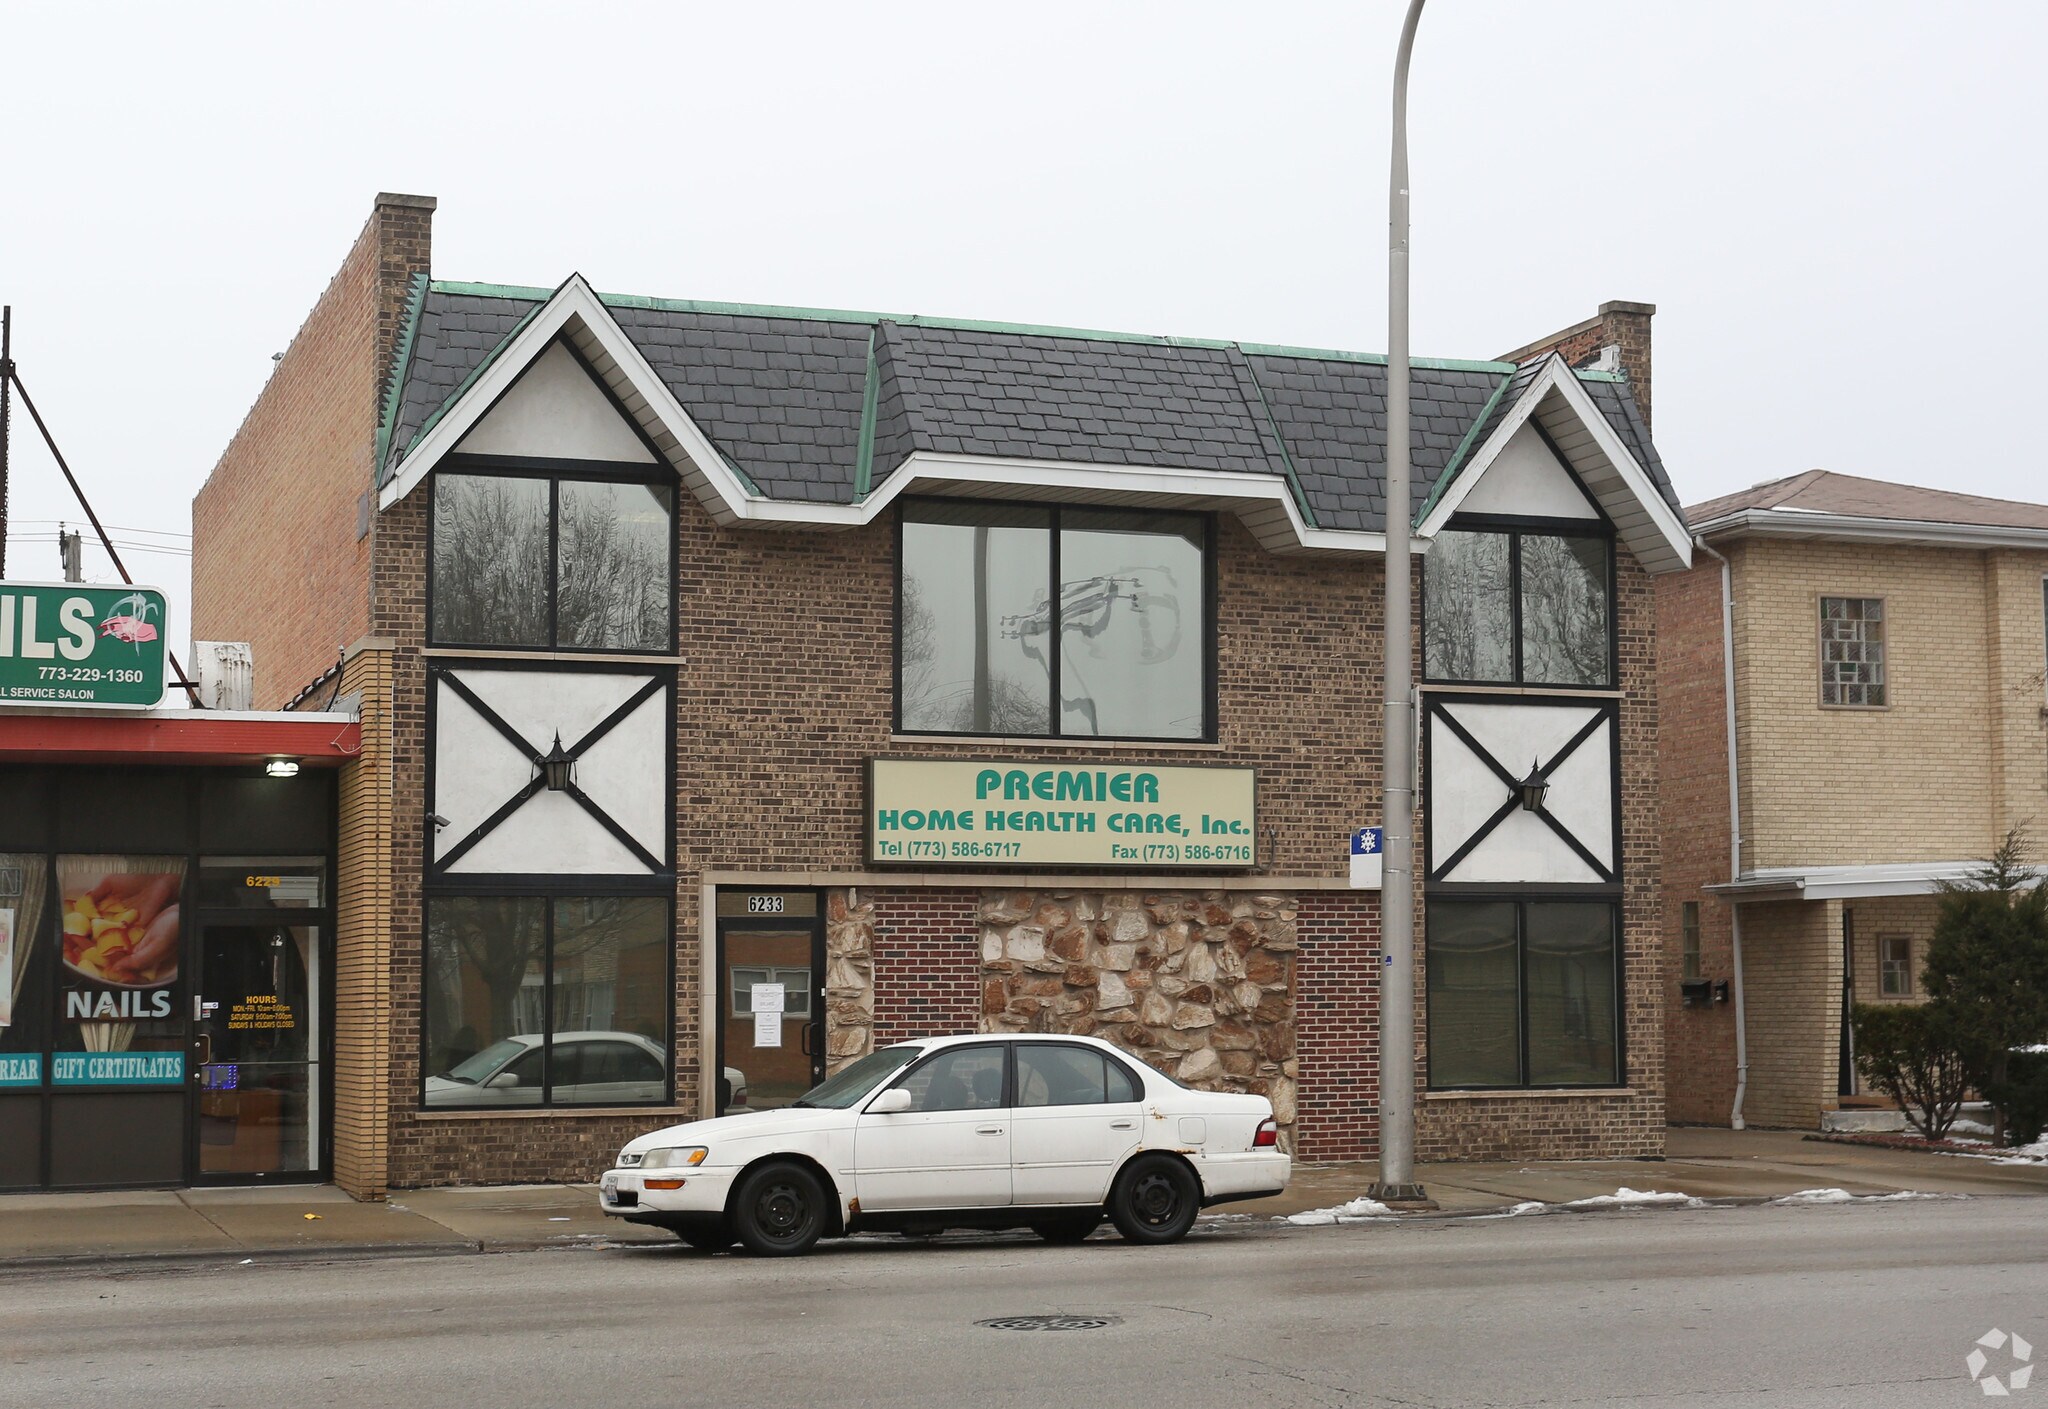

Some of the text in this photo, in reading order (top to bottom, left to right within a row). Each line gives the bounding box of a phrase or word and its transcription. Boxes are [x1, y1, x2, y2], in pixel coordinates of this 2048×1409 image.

[38, 667, 143, 683] 773-229-1360
[10, 687, 56, 698] SERVICE
[58, 689, 94, 700] SALON
[976, 769, 1159, 803] PREMIER
[878, 810, 1250, 838] HOME HEALTH CARE, Inc.
[878, 841, 1021, 860] Tel (773) 586-6717
[1112, 844, 1250, 862] Fax (773) 586-6716
[246, 876, 280, 887] 6229
[749, 896, 782, 912] 6233
[67, 990, 171, 1019] NAILS
[246, 995, 278, 1004] HOURS
[230, 1013, 255, 1021] SATURDAY
[276, 1020, 295, 1028] CLOSED
[54, 1057, 181, 1079] GIFT CERTIFICATES
